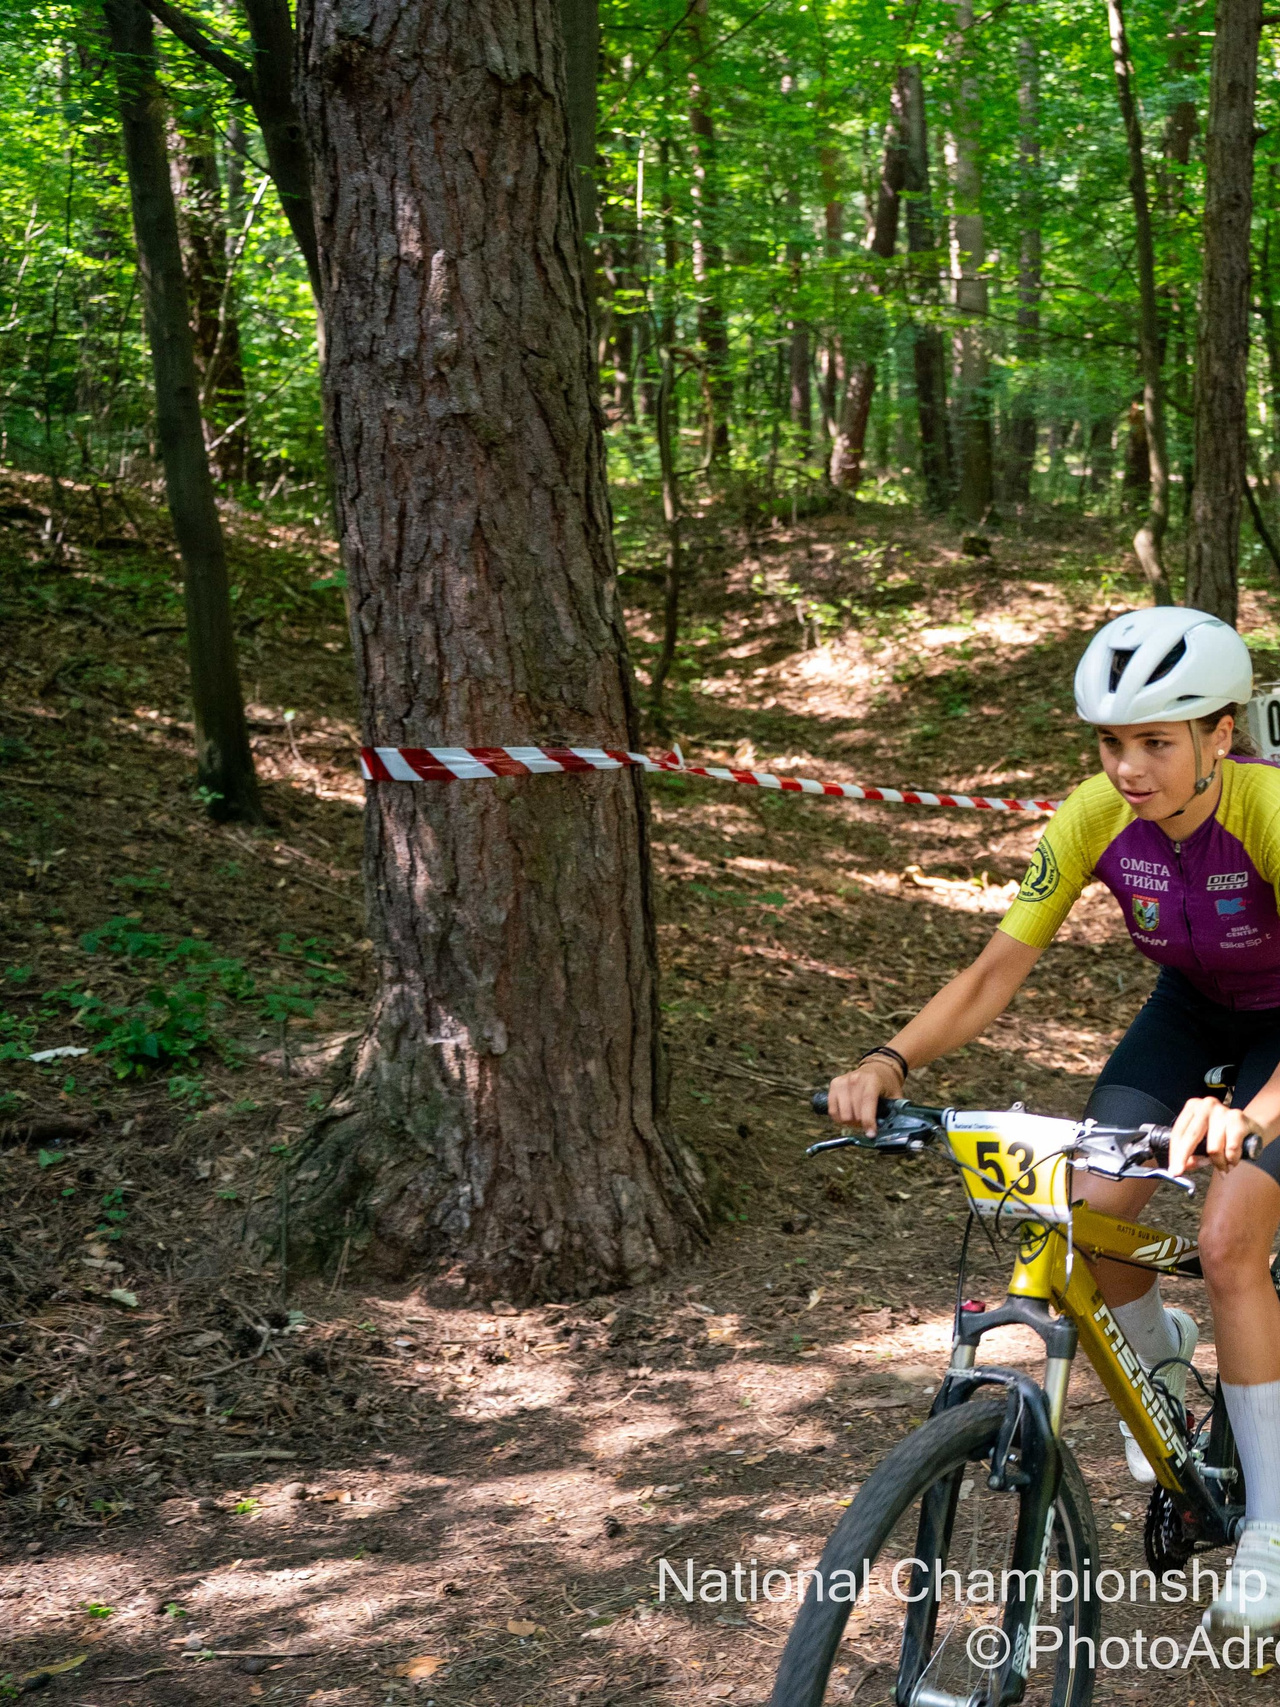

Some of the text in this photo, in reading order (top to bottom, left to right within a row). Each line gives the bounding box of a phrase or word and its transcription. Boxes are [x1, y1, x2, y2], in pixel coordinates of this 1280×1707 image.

[1119, 857, 1171, 877] ОМЕГА
[1122, 873, 1169, 892] ТИЙМ
[1209, 873, 1247, 885] DIEM
[976, 1141, 1037, 1196] 53
[1093, 1303, 1188, 1469] MERIDA
